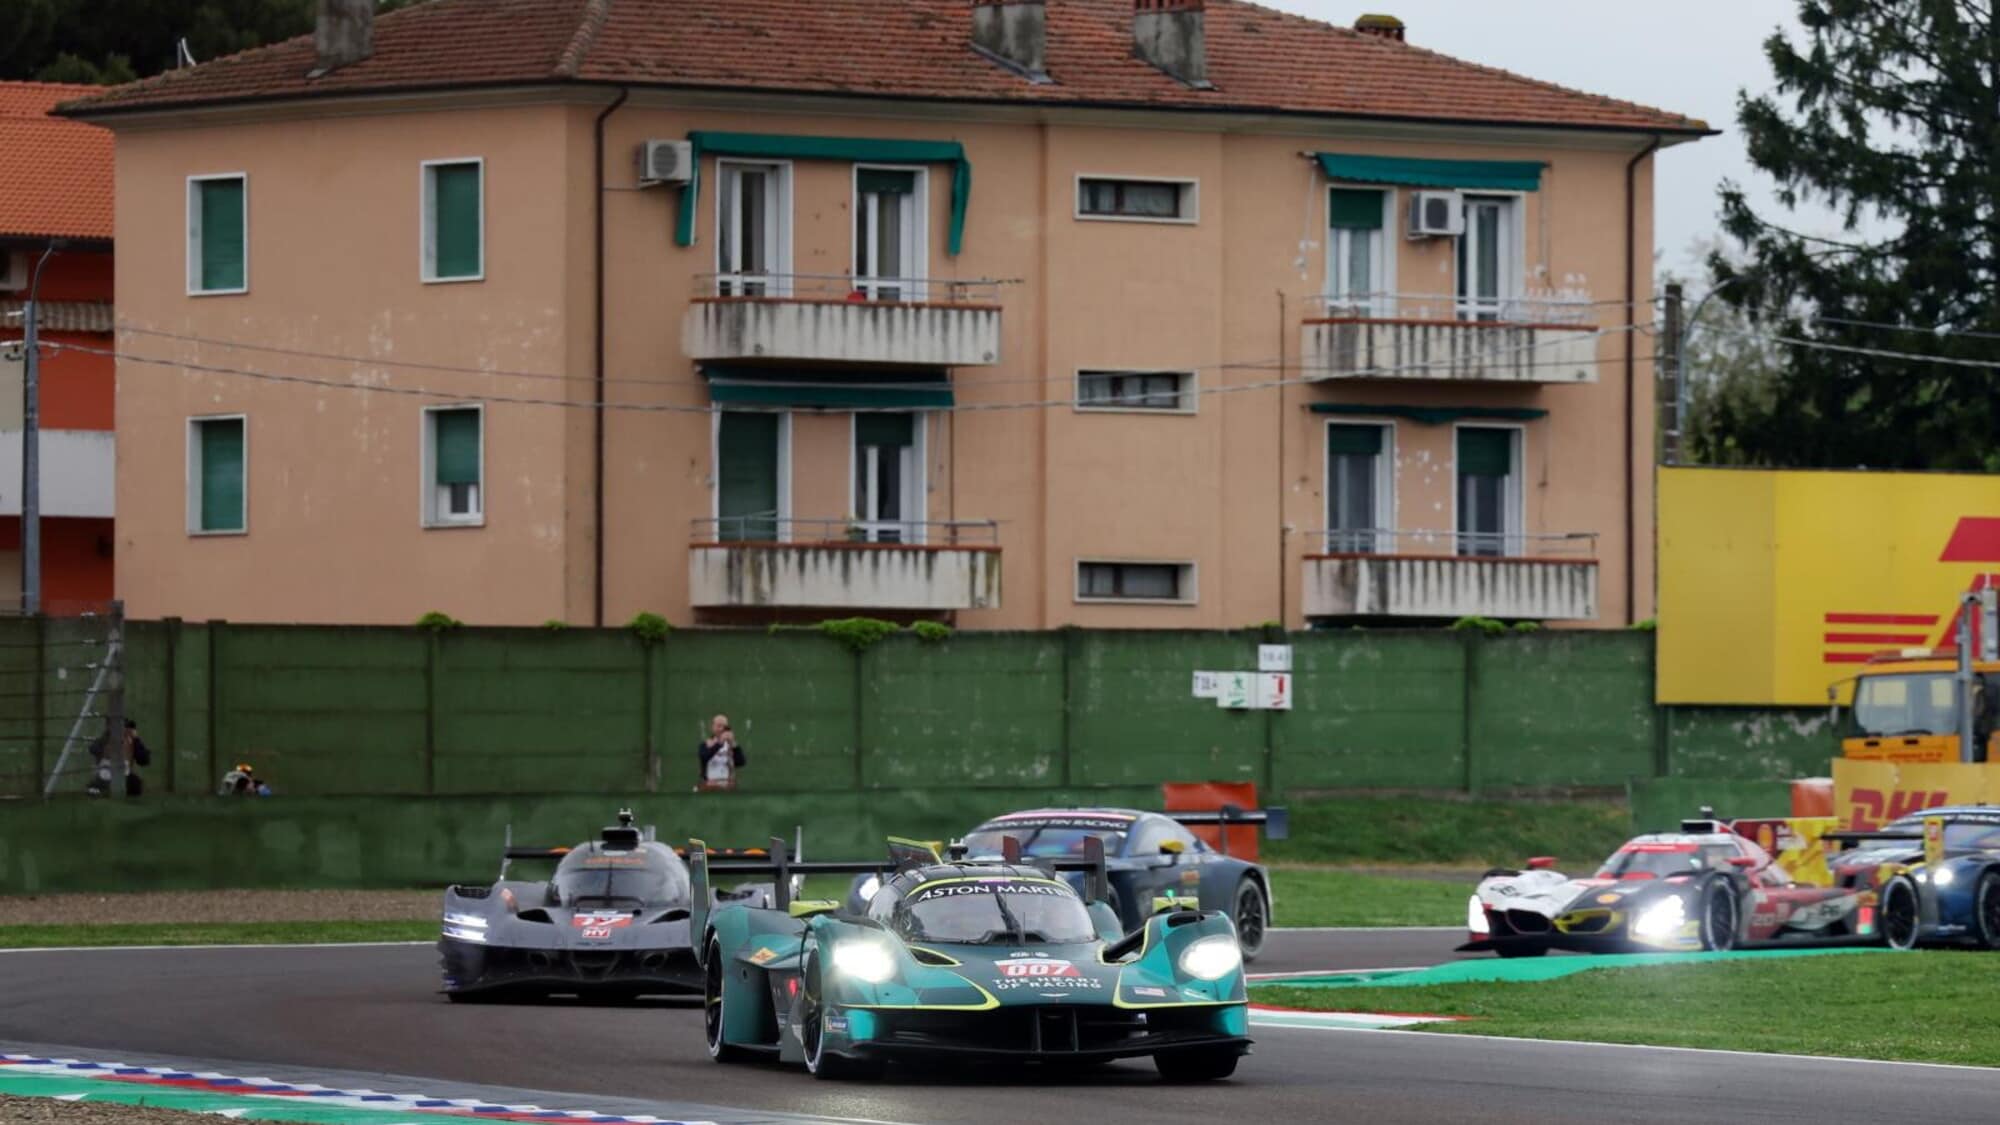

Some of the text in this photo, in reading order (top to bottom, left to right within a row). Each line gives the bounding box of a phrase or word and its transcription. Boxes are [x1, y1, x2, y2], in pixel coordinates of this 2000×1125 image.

[918, 885, 991, 902] ASTON
[585, 928, 609, 938] HY
[1006, 964, 1070, 976] 007
[992, 976, 1100, 984] THE HEART
[997, 981, 1102, 990] OF RACING
